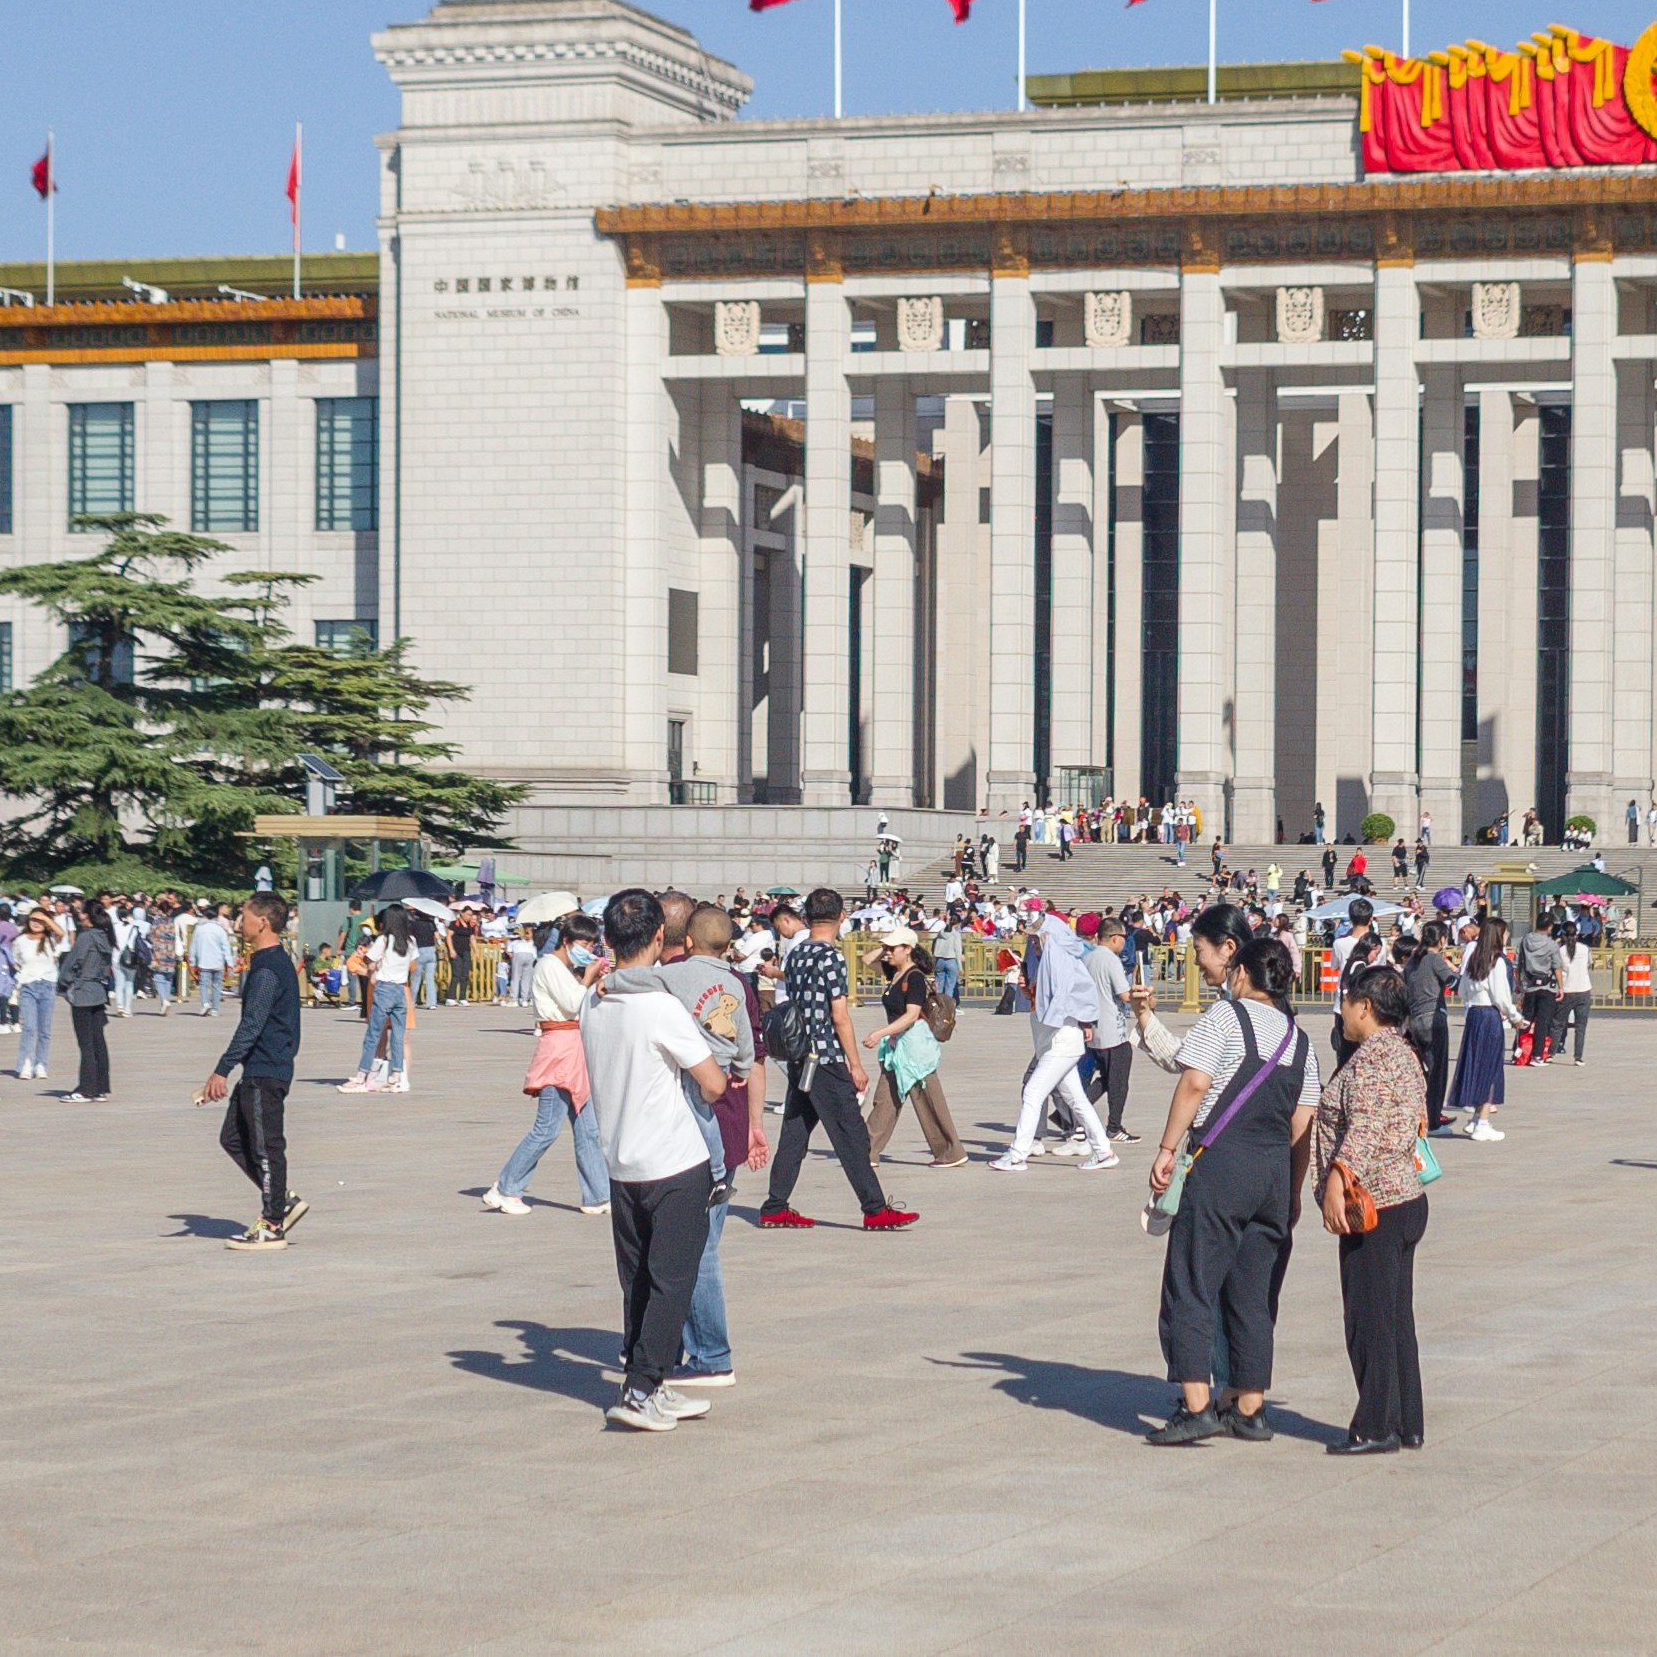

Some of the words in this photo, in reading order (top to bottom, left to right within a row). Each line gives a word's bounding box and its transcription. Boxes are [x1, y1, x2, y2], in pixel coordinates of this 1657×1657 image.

[434, 310, 479, 319] NATIONAL
[487, 309, 526, 318] MUSEUM
[532, 308, 545, 317] OF
[551, 308, 580, 317] CHINA
